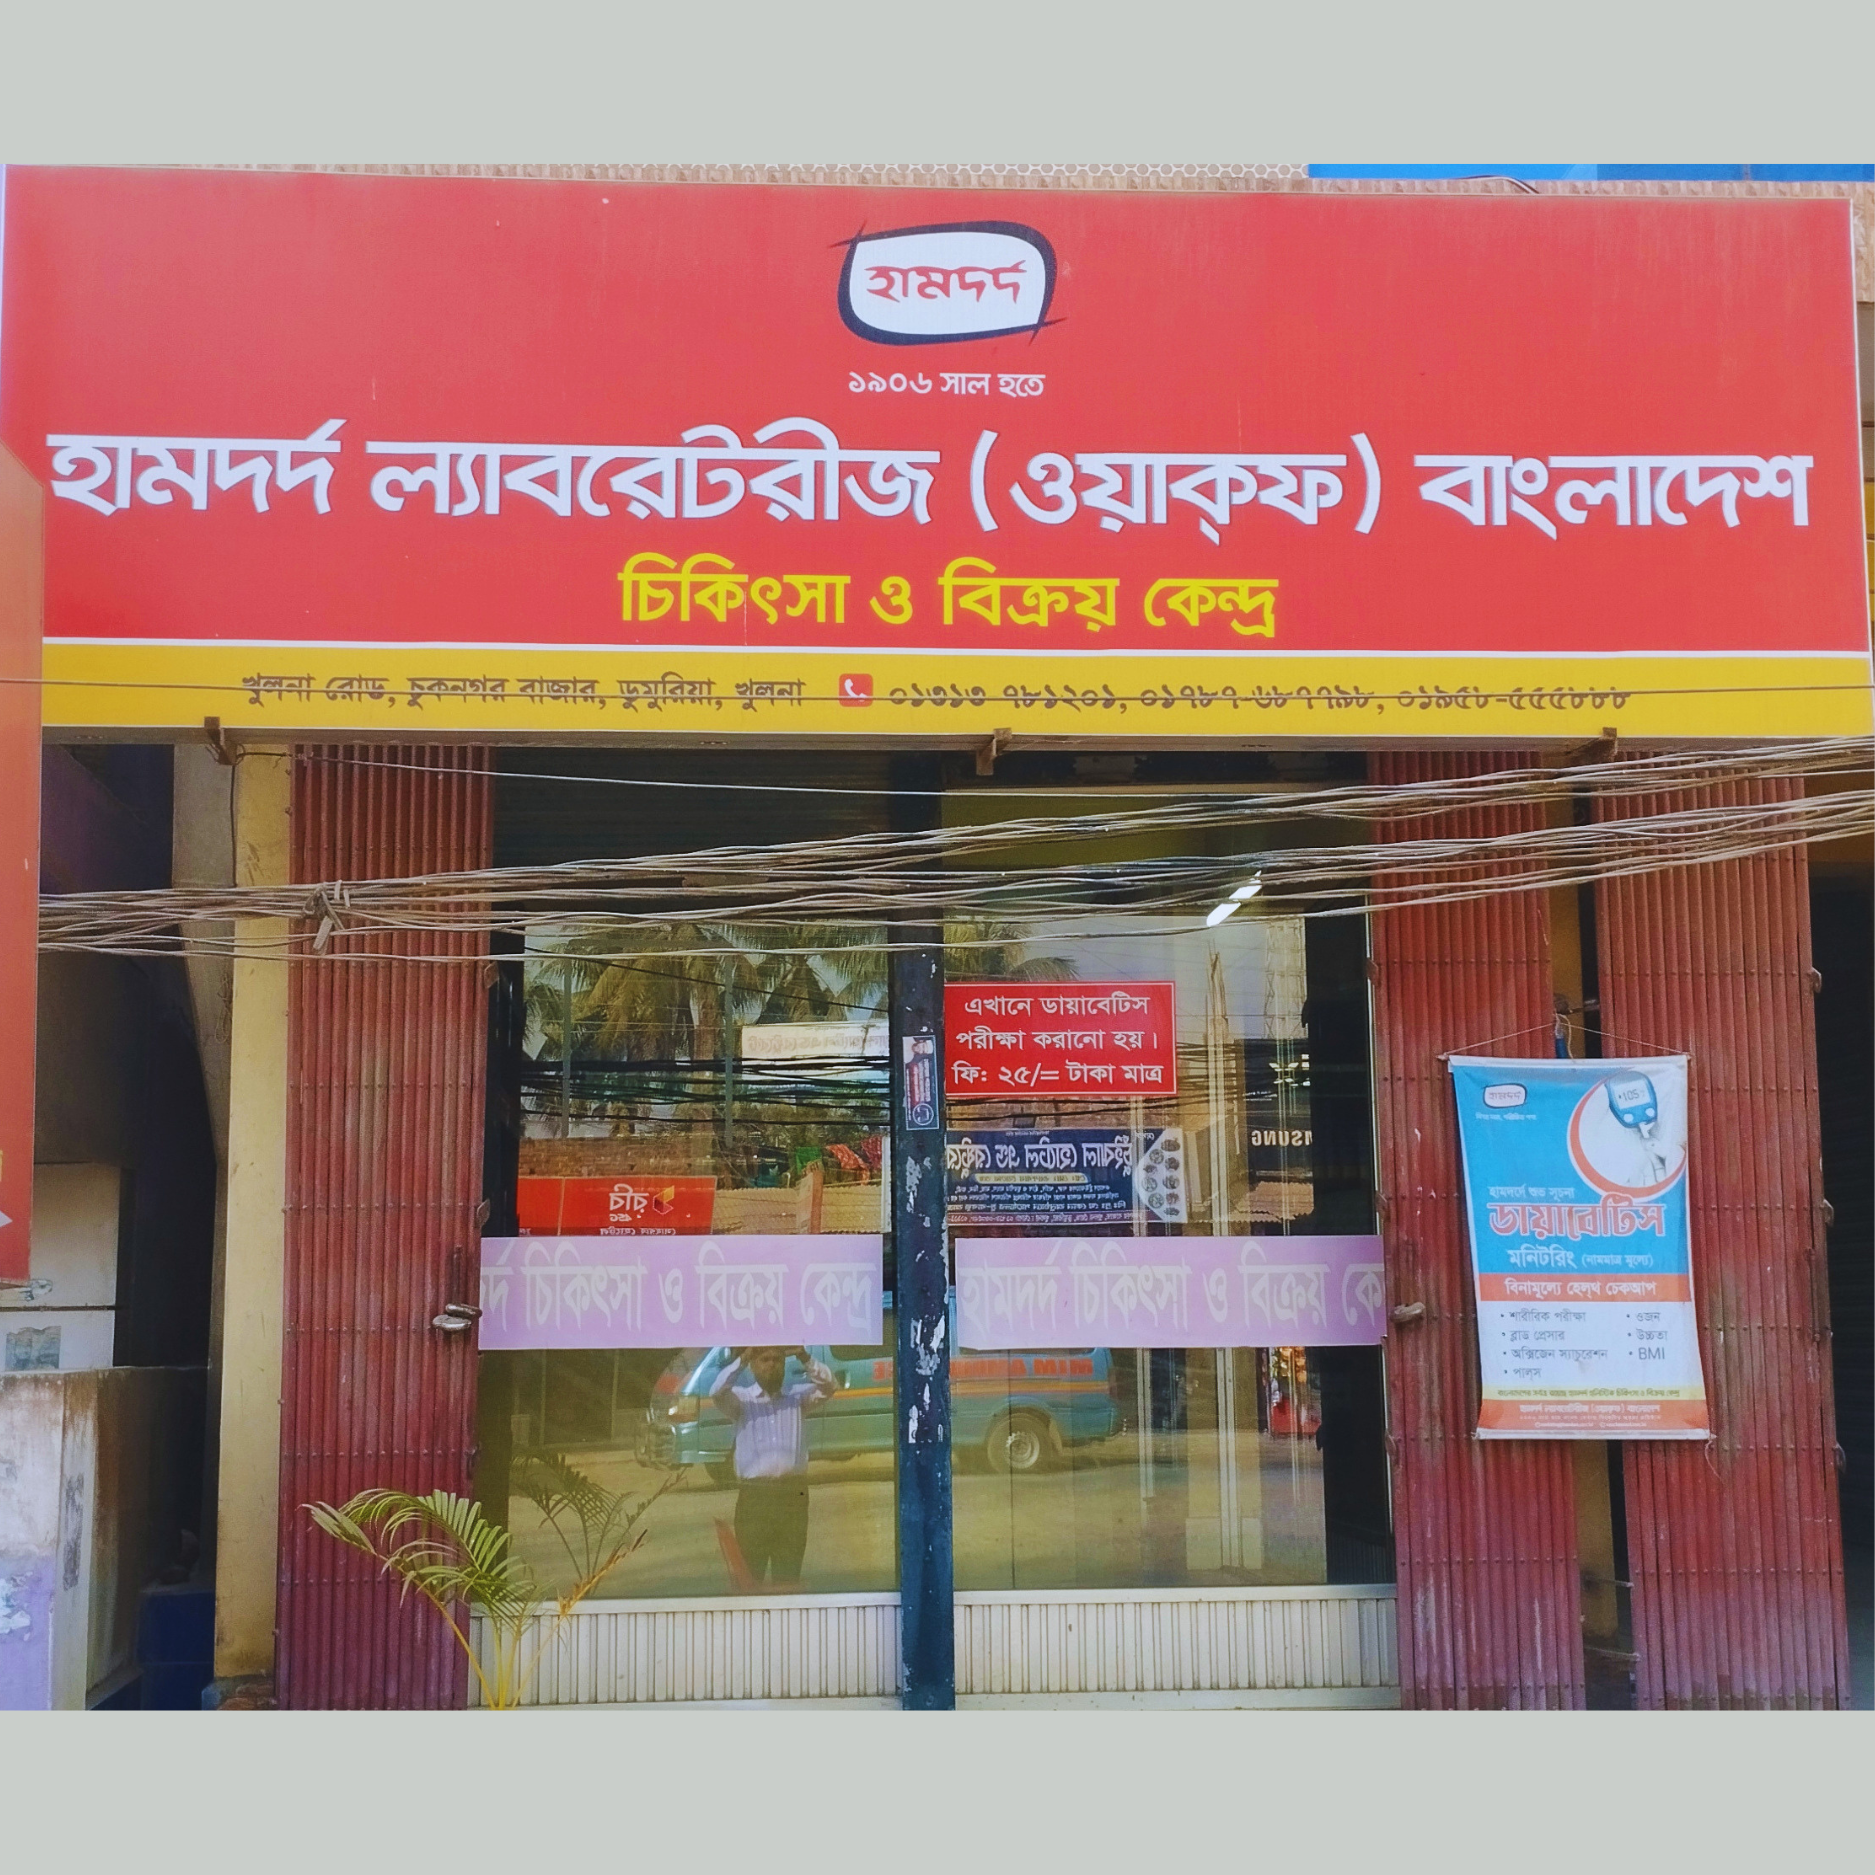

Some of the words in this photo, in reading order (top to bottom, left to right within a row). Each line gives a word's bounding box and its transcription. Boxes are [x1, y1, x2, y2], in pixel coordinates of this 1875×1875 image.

[864, 259, 1027, 304] হামদর্দ
[848, 371, 932, 393] ১৯০৬
[940, 373, 990, 396] সাল
[997, 374, 1046, 398] হতে
[46, 419, 347, 517] হামদর্দ
[366, 417, 943, 524] ল্যাবরেটরীজ
[1415, 453, 1813, 541] বাংলাদেশ
[618, 551, 850, 624] চিকিৎসা
[870, 575, 913, 626] ও
[939, 557, 1119, 633] বিক্রয়
[1144, 578, 1279, 638] কেন্দ্র
[242, 673, 315, 708] খুলনা
[325, 674, 395, 708] রোড,
[407, 674, 509, 710] চুকনগর
[517, 676, 607, 709] বাজার,
[616, 671, 722, 712] ডুমুরিয়া,
[735, 678, 806, 712] খুলনা
[965, 996, 1033, 1017] এখানে
[1039, 991, 1150, 1017] ডায়াবেটিস
[956, 1027, 1026, 1050] পরীক্ষা
[1032, 1031, 1104, 1051] করানো
[1066, 1060, 1116, 1084] টাকা
[1121, 1065, 1164, 1084] মাত্র
[1550, 1187, 1575, 1201] সূচনা
[1487, 1191, 1667, 1240] ডায়াবেটিস
[1507, 1244, 1577, 1268] মনিটরিং
[480, 1240, 514, 1333] র্দ
[520, 1241, 648, 1333] চিকিৎসা
[658, 1267, 684, 1324] ও
[694, 1242, 788, 1331] বিক্রয়
[801, 1262, 876, 1337] কেন্দ্র
[958, 1240, 1061, 1342] হামদর্দ
[1069, 1241, 1190, 1331] চিকিৎসা
[1203, 1267, 1228, 1324] ও
[1238, 1240, 1330, 1328] বিক্রয়
[1504, 1277, 1562, 1299] বিনামূল্যে
[1605, 1281, 1657, 1296] চেকআপ
[1509, 1308, 1550, 1322] শারীরিক
[1554, 1308, 1586, 1322] পরীক্ষা
[1636, 1312, 1661, 1322] ওজন
[1636, 1328, 1668, 1341] উচ্চতা
[1638, 1348, 1665, 1360] BMI
